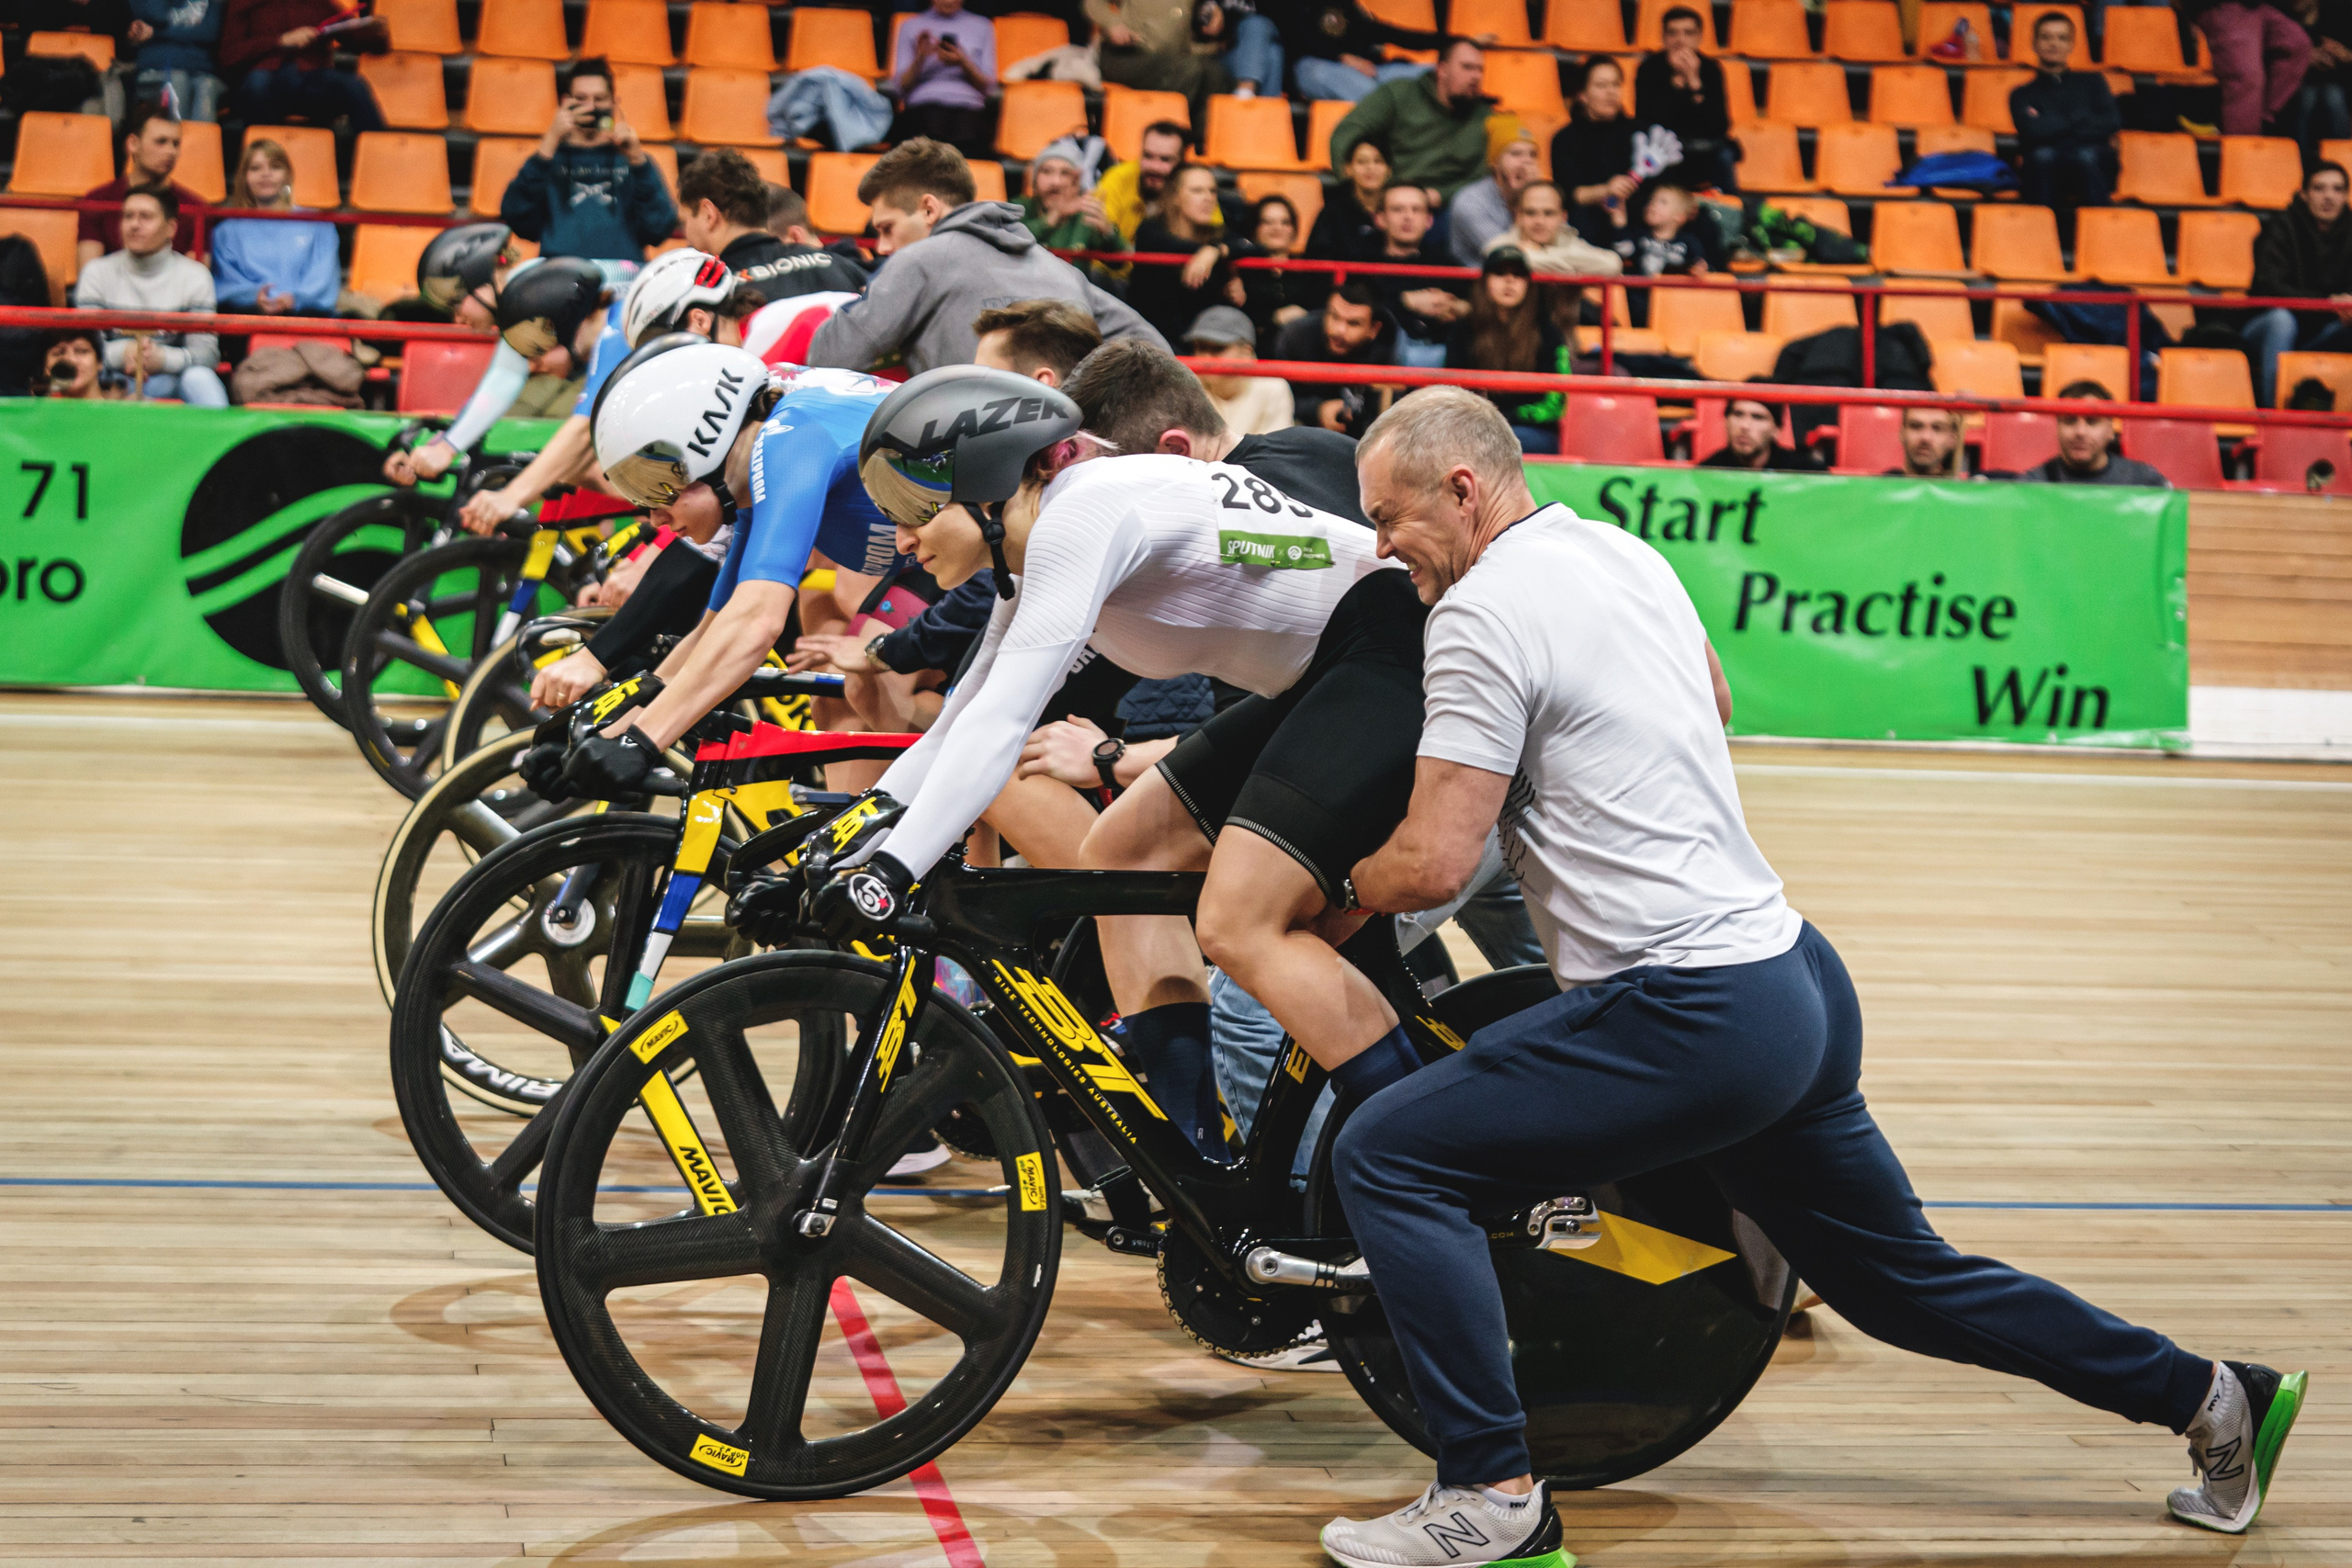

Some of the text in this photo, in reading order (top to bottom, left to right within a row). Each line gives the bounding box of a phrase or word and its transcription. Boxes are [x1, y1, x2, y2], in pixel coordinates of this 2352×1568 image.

[687, 367, 745, 457] KASK
[918, 397, 1070, 448] LAZER
[21, 461, 89, 520] 71
[1600, 476, 1766, 544] Start
[1227, 540, 1276, 558] SPUTNIK
[0, 557, 85, 603] ro
[1734, 571, 2018, 640] Practise
[1973, 662, 2111, 729] Win
[646, 1024, 673, 1049] MAVIC
[994, 976, 1137, 1145] BIKE TECHNOLOGIES AUSTRALIA
[706, 1448, 736, 1464] MAVIC
